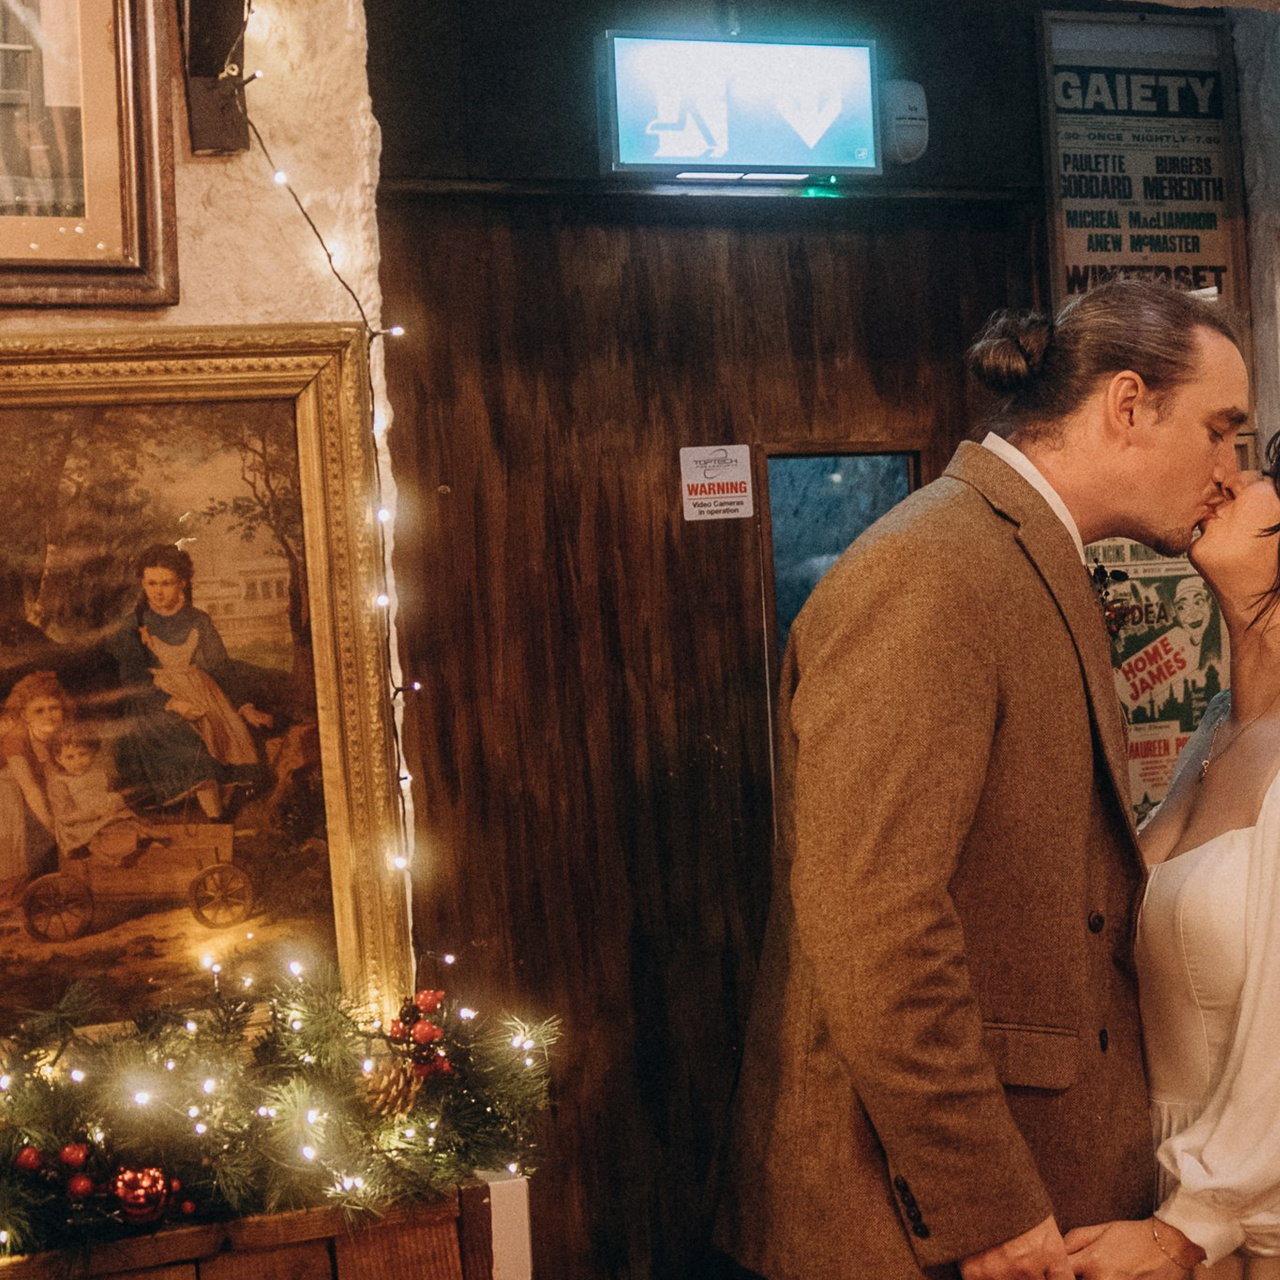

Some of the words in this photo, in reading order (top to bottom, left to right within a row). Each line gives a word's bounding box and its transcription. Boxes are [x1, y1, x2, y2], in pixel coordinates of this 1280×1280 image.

[1054, 71, 1216, 114] GAIETY
[1087, 132, 1124, 141] ONCE
[1132, 134, 1187, 144] NIGHTLY
[1063, 153, 1126, 174] PAULETTE
[1156, 156, 1212, 175] BURGESS
[1143, 177, 1224, 201] MEREDITH
[687, 481, 747, 496] WARNING
[692, 500, 711, 508] Video
[706, 507, 739, 515] operation
